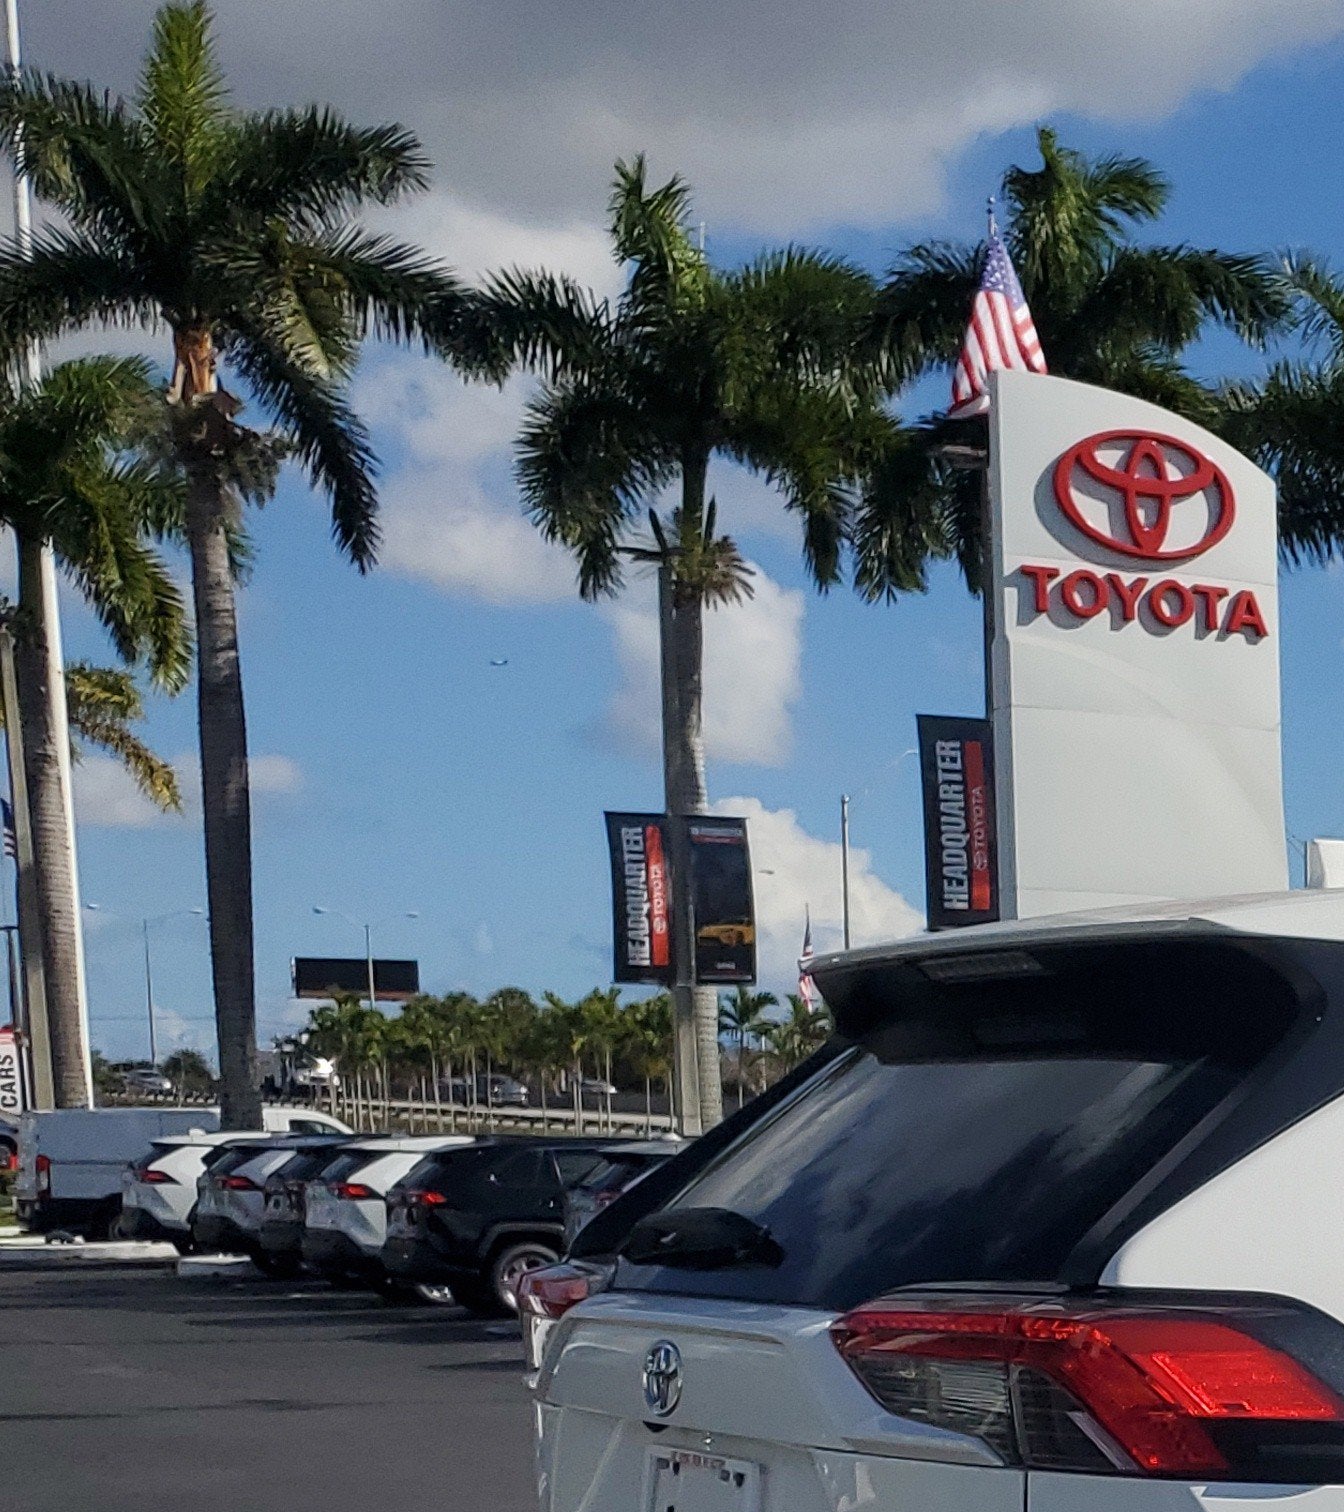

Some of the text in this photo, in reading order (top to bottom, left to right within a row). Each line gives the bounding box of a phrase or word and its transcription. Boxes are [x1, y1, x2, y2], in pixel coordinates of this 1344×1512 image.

[1020, 564, 1269, 637] TOYOTA
[935, 739, 970, 910] HEADQUARTER
[972, 786, 987, 848] TOYOTA
[621, 827, 650, 966] HEADQUARTER
